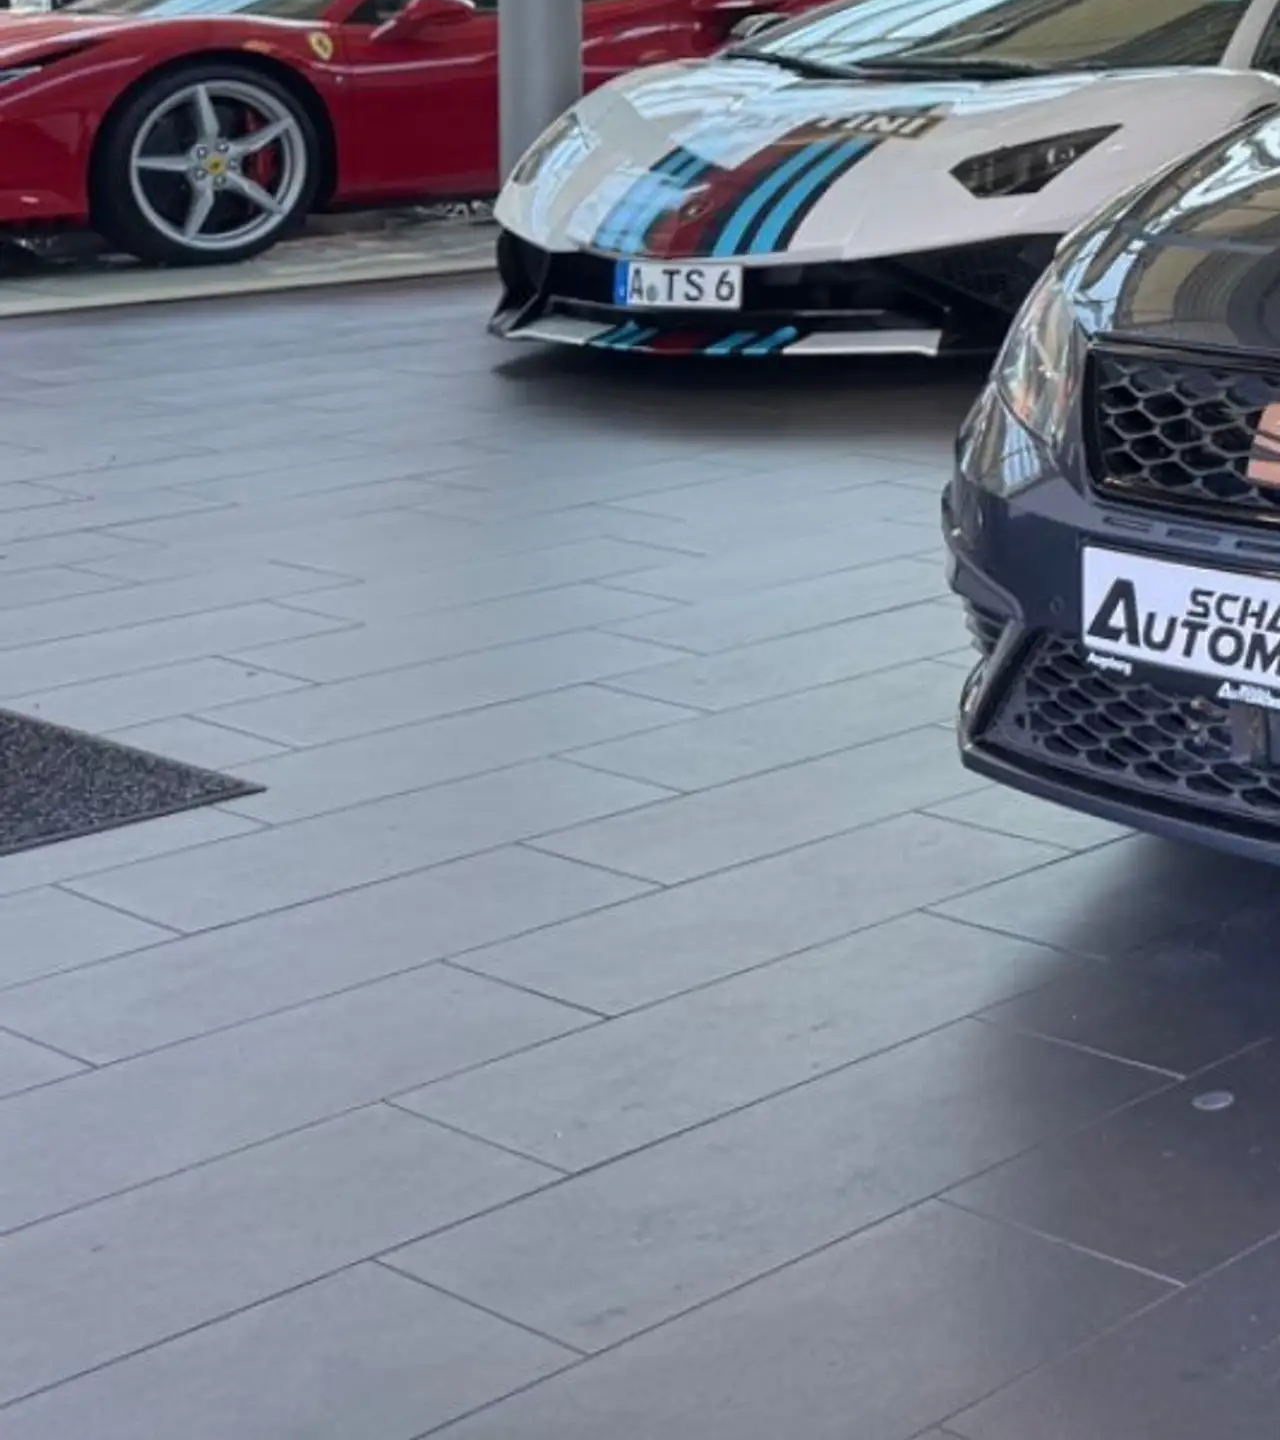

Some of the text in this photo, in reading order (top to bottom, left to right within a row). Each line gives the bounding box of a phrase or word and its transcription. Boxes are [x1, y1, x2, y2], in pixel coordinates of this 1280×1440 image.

[629, 266, 735, 302] A TS 6
